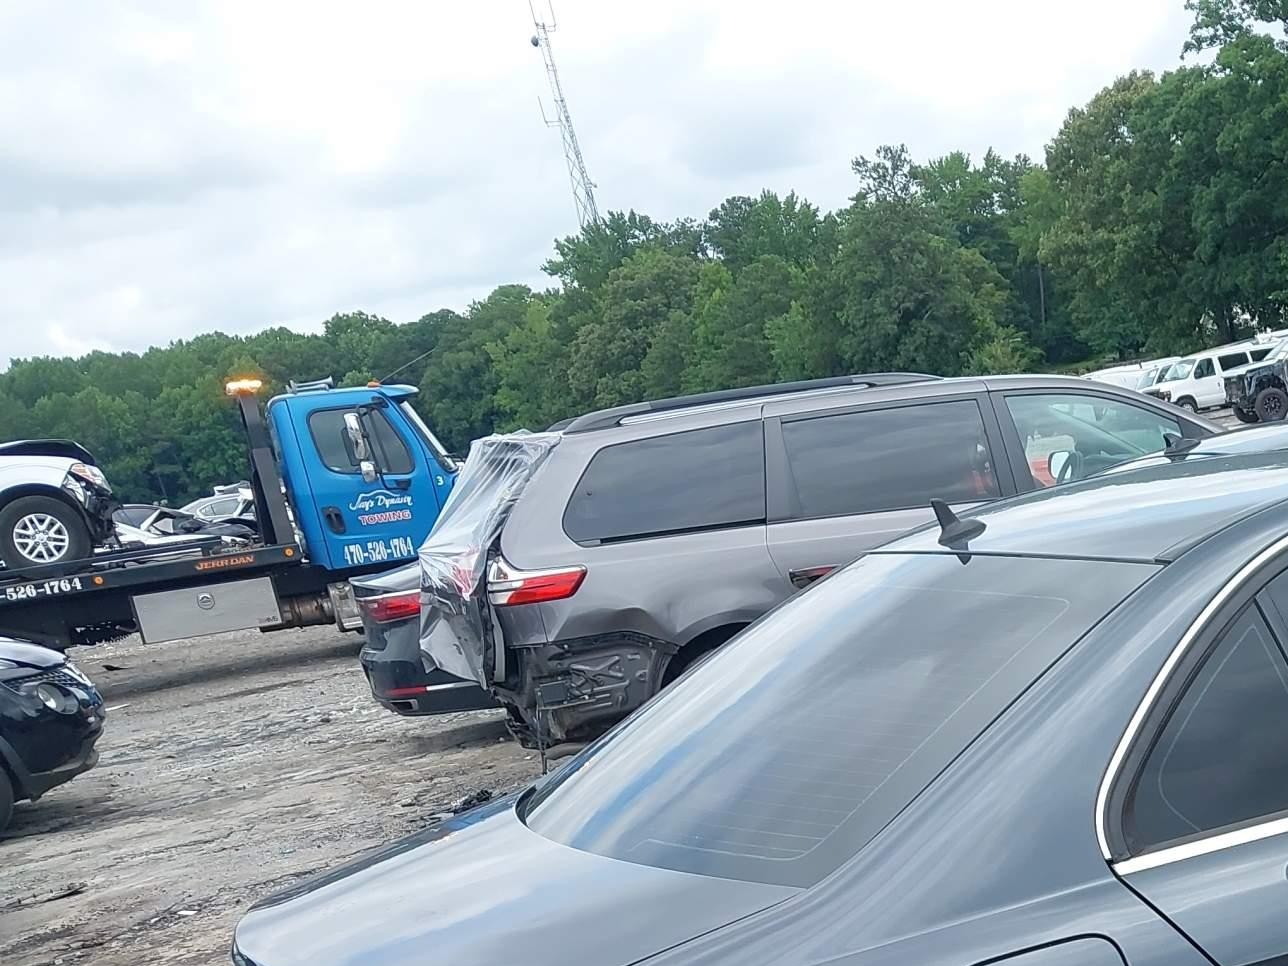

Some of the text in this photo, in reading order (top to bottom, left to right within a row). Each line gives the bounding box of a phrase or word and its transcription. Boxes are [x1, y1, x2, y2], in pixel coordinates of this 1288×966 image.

[436, 475, 444, 486] 3
[358, 509, 412, 525] TOWING
[344, 536, 415, 565] 470-526-1764
